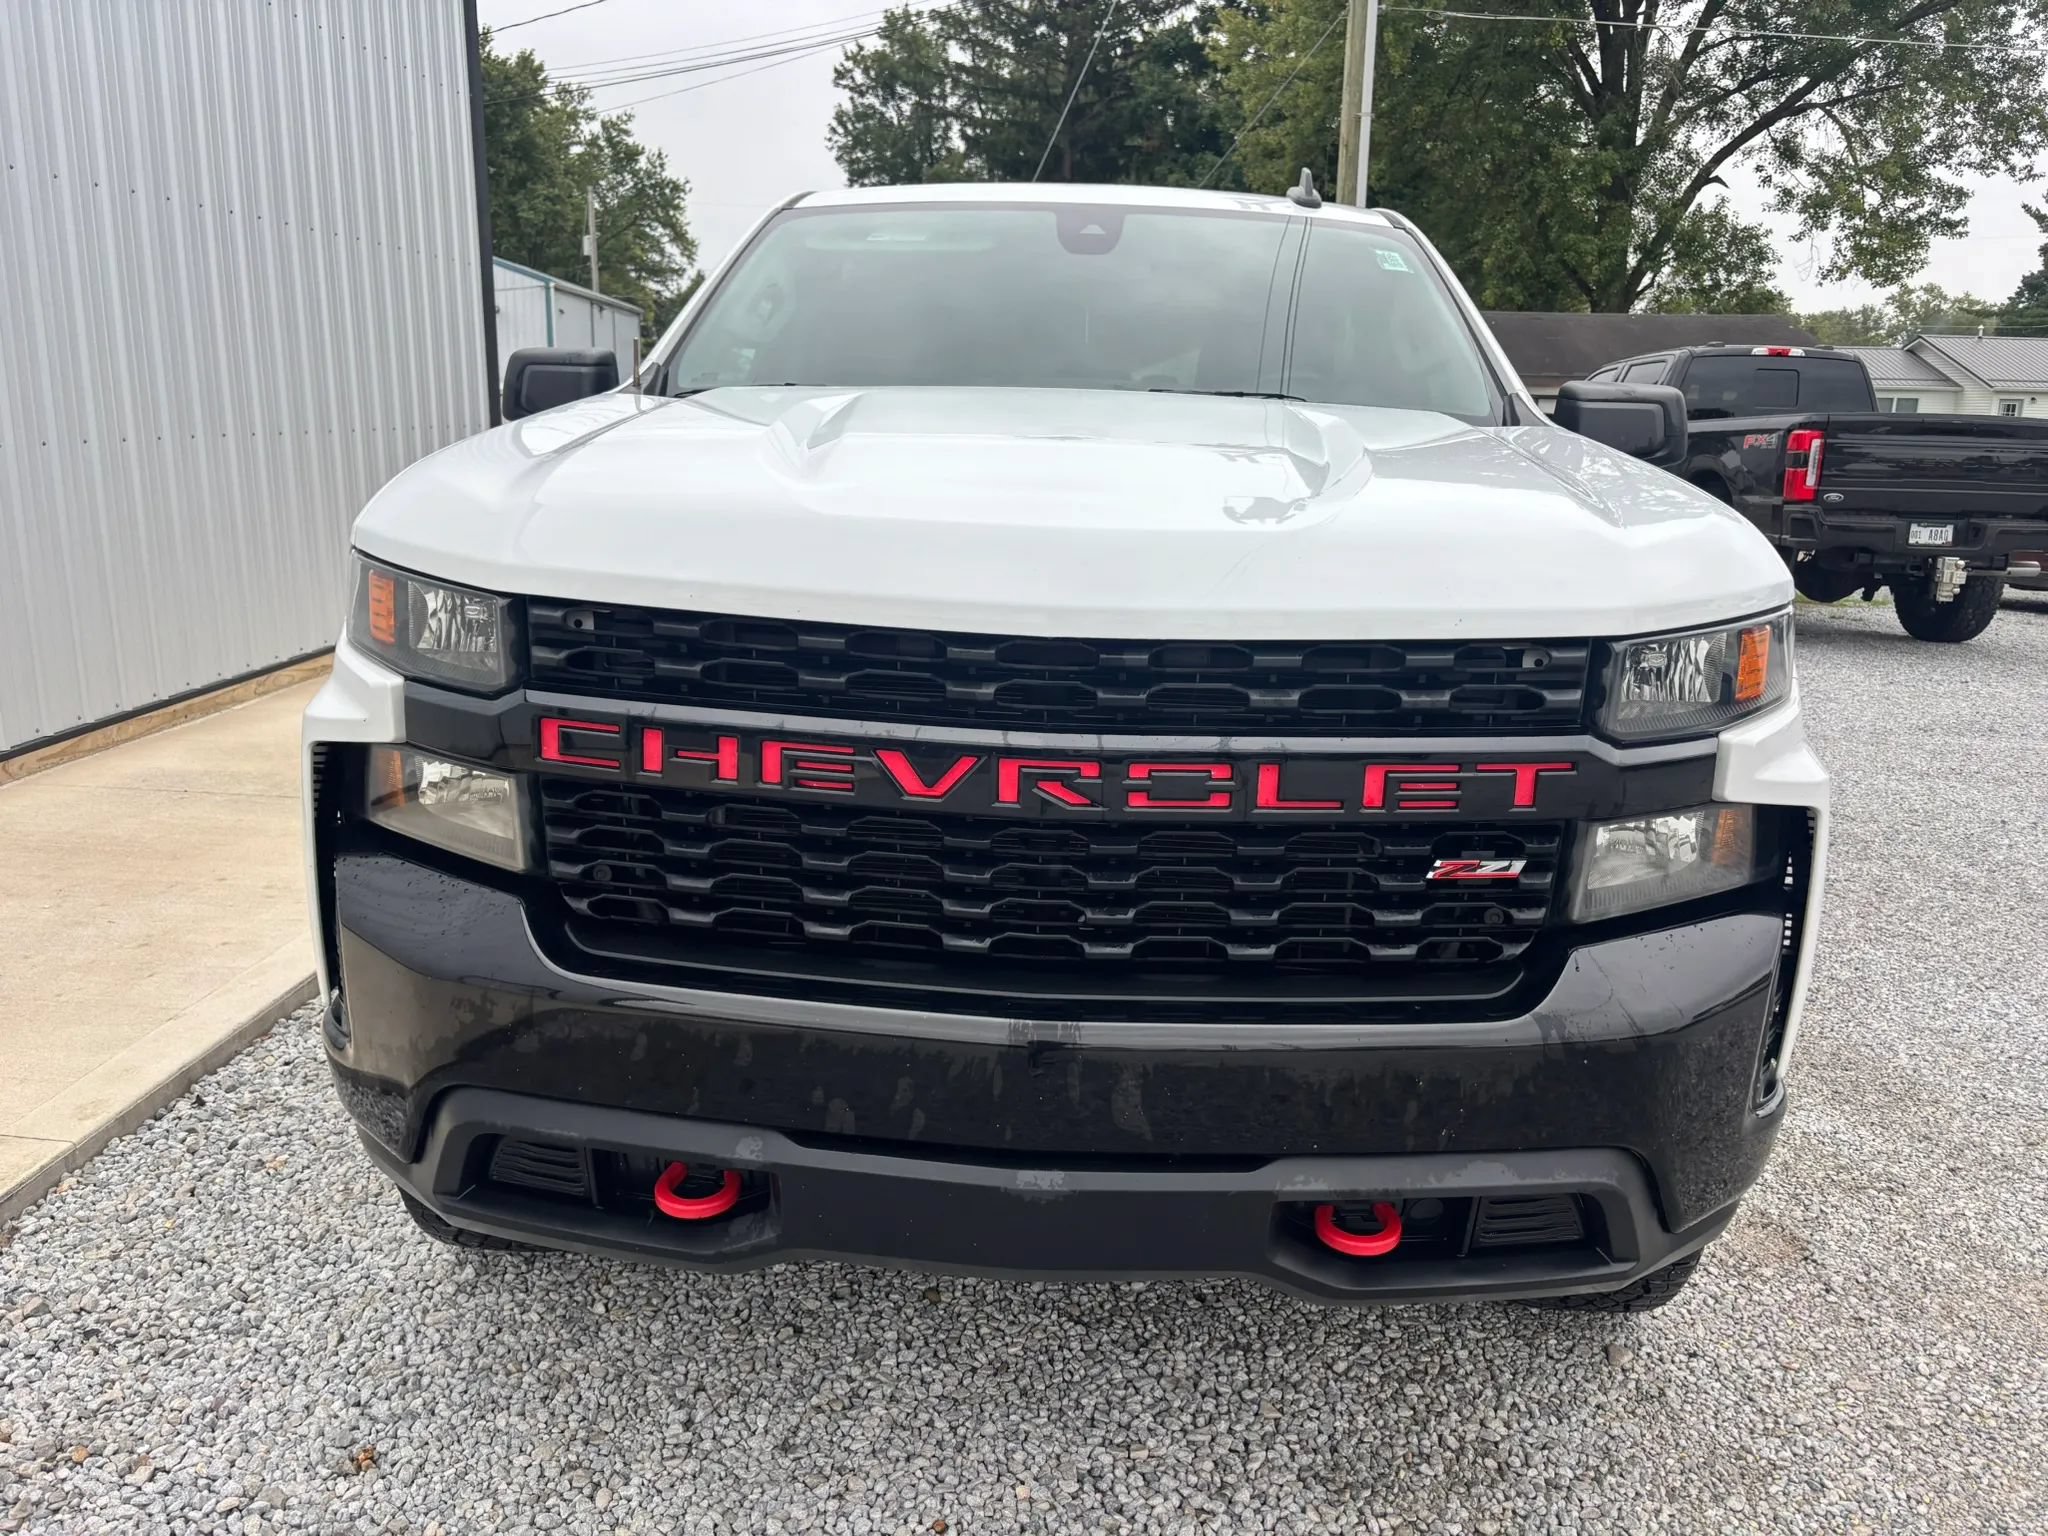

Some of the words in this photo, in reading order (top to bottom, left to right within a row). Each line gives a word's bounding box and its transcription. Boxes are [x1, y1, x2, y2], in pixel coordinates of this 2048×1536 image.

[1743, 432, 1778, 449] FX4
[539, 717, 1574, 808] CHEVROLET
[1426, 860, 1527, 879] Z71
